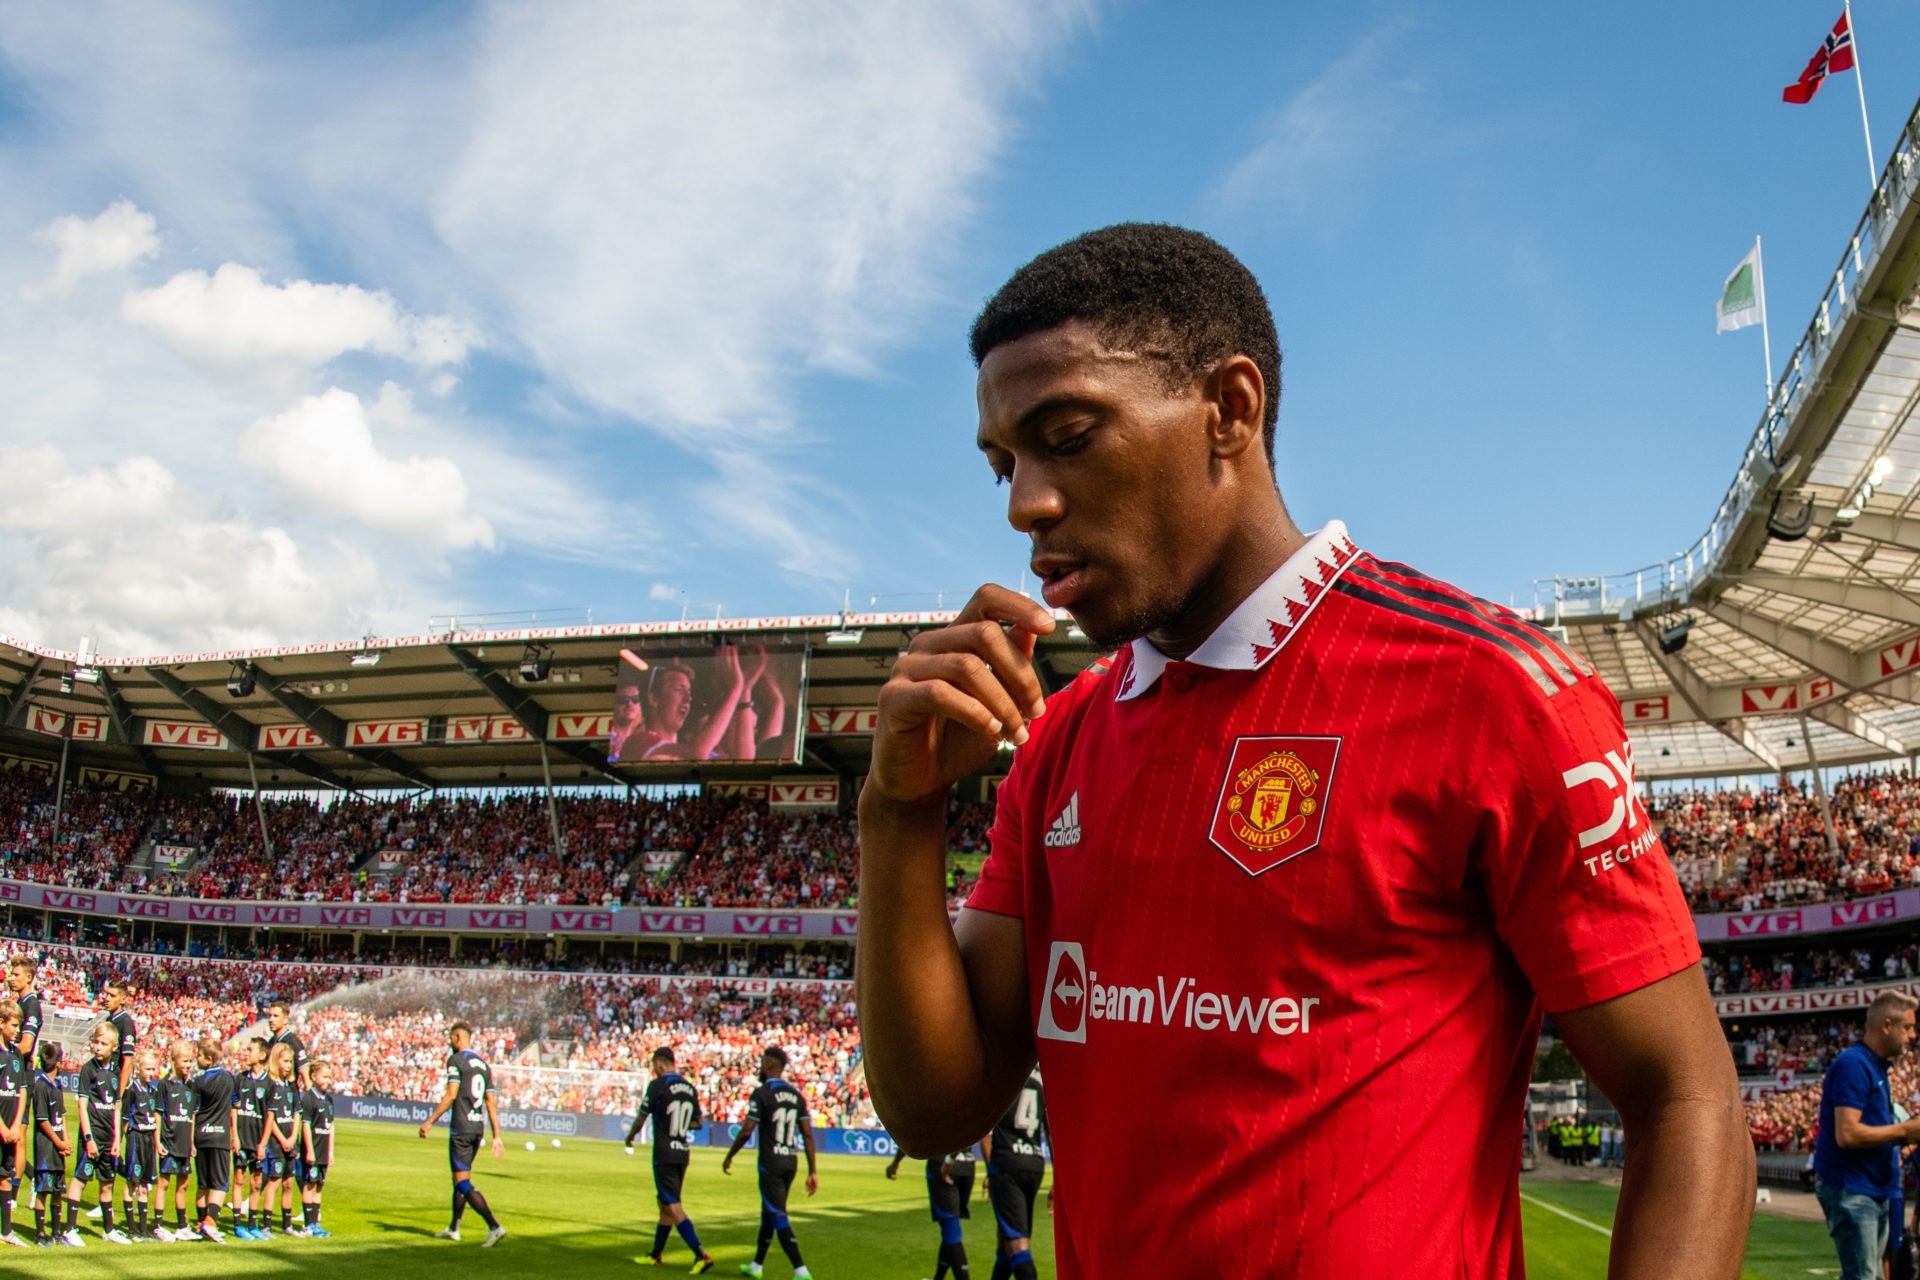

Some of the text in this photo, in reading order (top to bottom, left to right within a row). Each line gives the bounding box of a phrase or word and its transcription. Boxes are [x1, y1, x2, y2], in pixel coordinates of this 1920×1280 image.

[1882, 639, 1920, 671] V
[1622, 699, 1663, 721] G
[38, 711, 98, 738] VG
[156, 724, 219, 746] VG
[357, 722, 418, 743] VG
[457, 718, 524, 739] VG
[269, 728, 323, 746] VG
[1241, 757, 1311, 792] MANCHESTER
[776, 786, 833, 800] VG
[1045, 825, 1081, 847] adidas
[1240, 826, 1290, 844] UNITED
[45, 892, 94, 909] VG
[121, 900, 167, 916] VG
[191, 905, 234, 920] VG
[256, 907, 299, 922] VG
[323, 909, 368, 924] VG
[395, 910, 443, 926] VG
[472, 911, 525, 928] VG
[555, 913, 610, 929] VG
[643, 915, 703, 931] VG
[737, 916, 799, 933] VG
[1730, 899, 1894, 934] VG VG
[1752, 997, 1804, 1011] VG
[1812, 992, 1858, 1007] VG
[471, 1073, 485, 1109] 9
[352, 1101, 376, 1117] Kjøp
[379, 1103, 411, 1120] halve,
[413, 1106, 428, 1119] bo
[487, 1111, 527, 1129] BOS
[666, 1101, 693, 1137] 10
[1014, 1088, 1039, 1138] 4
[772, 1107, 797, 1147] 11
